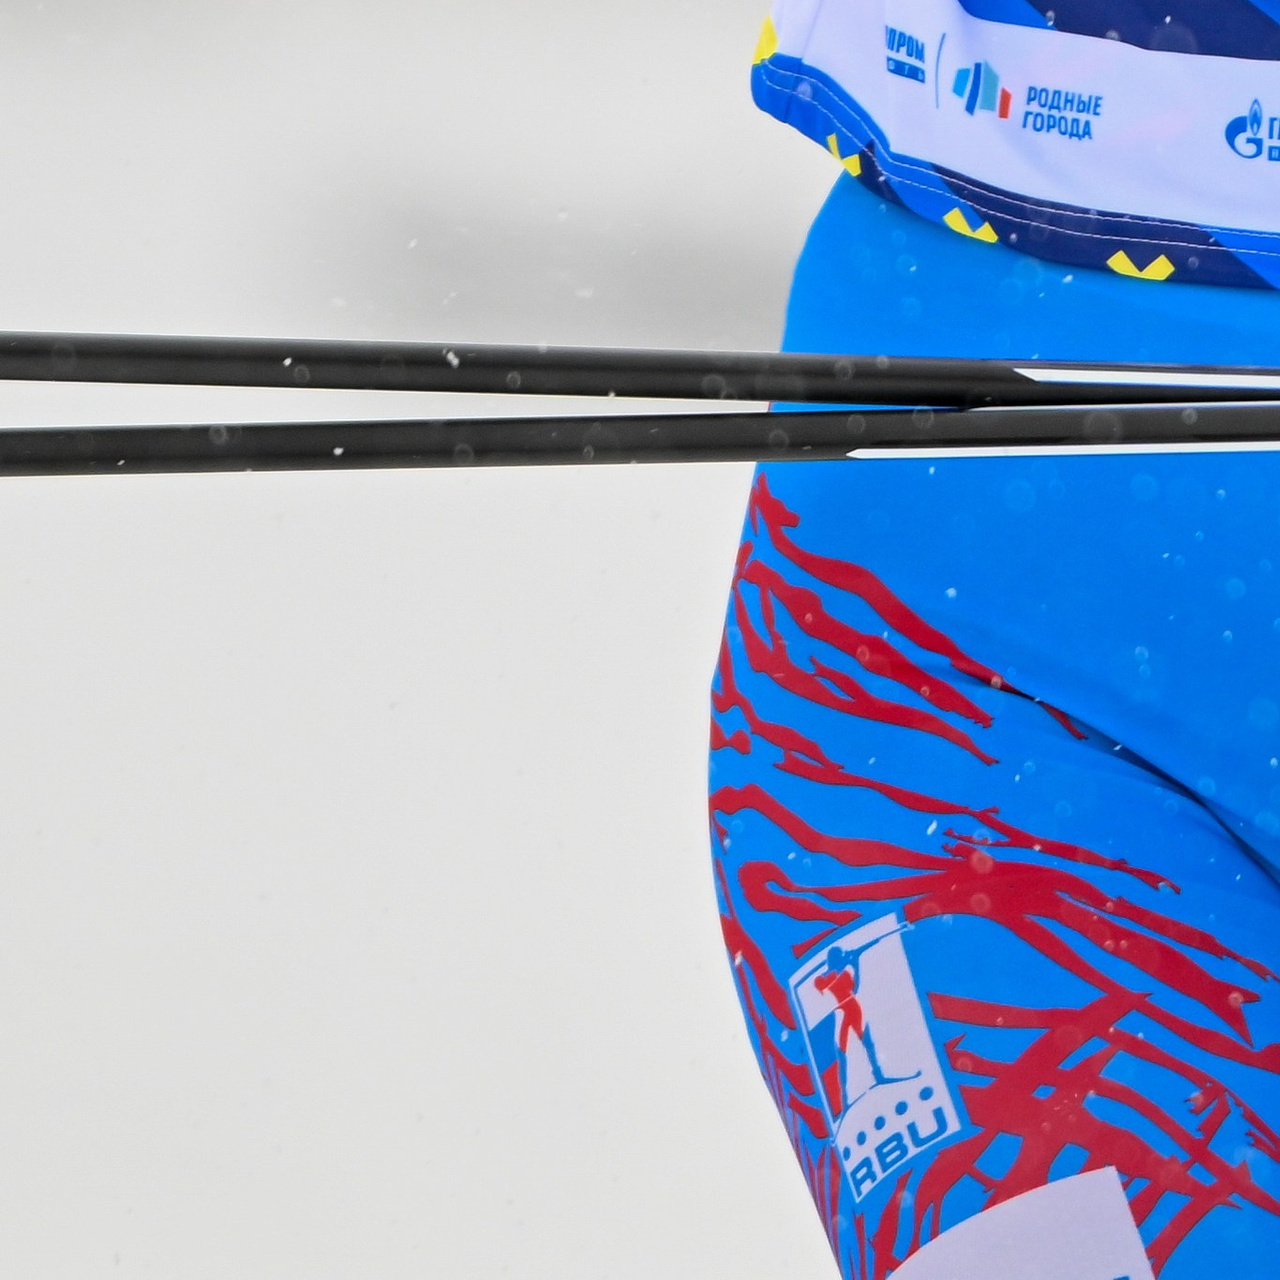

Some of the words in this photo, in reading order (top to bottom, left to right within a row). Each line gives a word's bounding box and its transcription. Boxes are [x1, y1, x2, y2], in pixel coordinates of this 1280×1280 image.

[886, 25, 926, 64] ПРОМ
[1026, 85, 1103, 116] РОДНЫЕ
[1022, 110, 1093, 141] ГОРОДА
[850, 1106, 948, 1199] RBU
